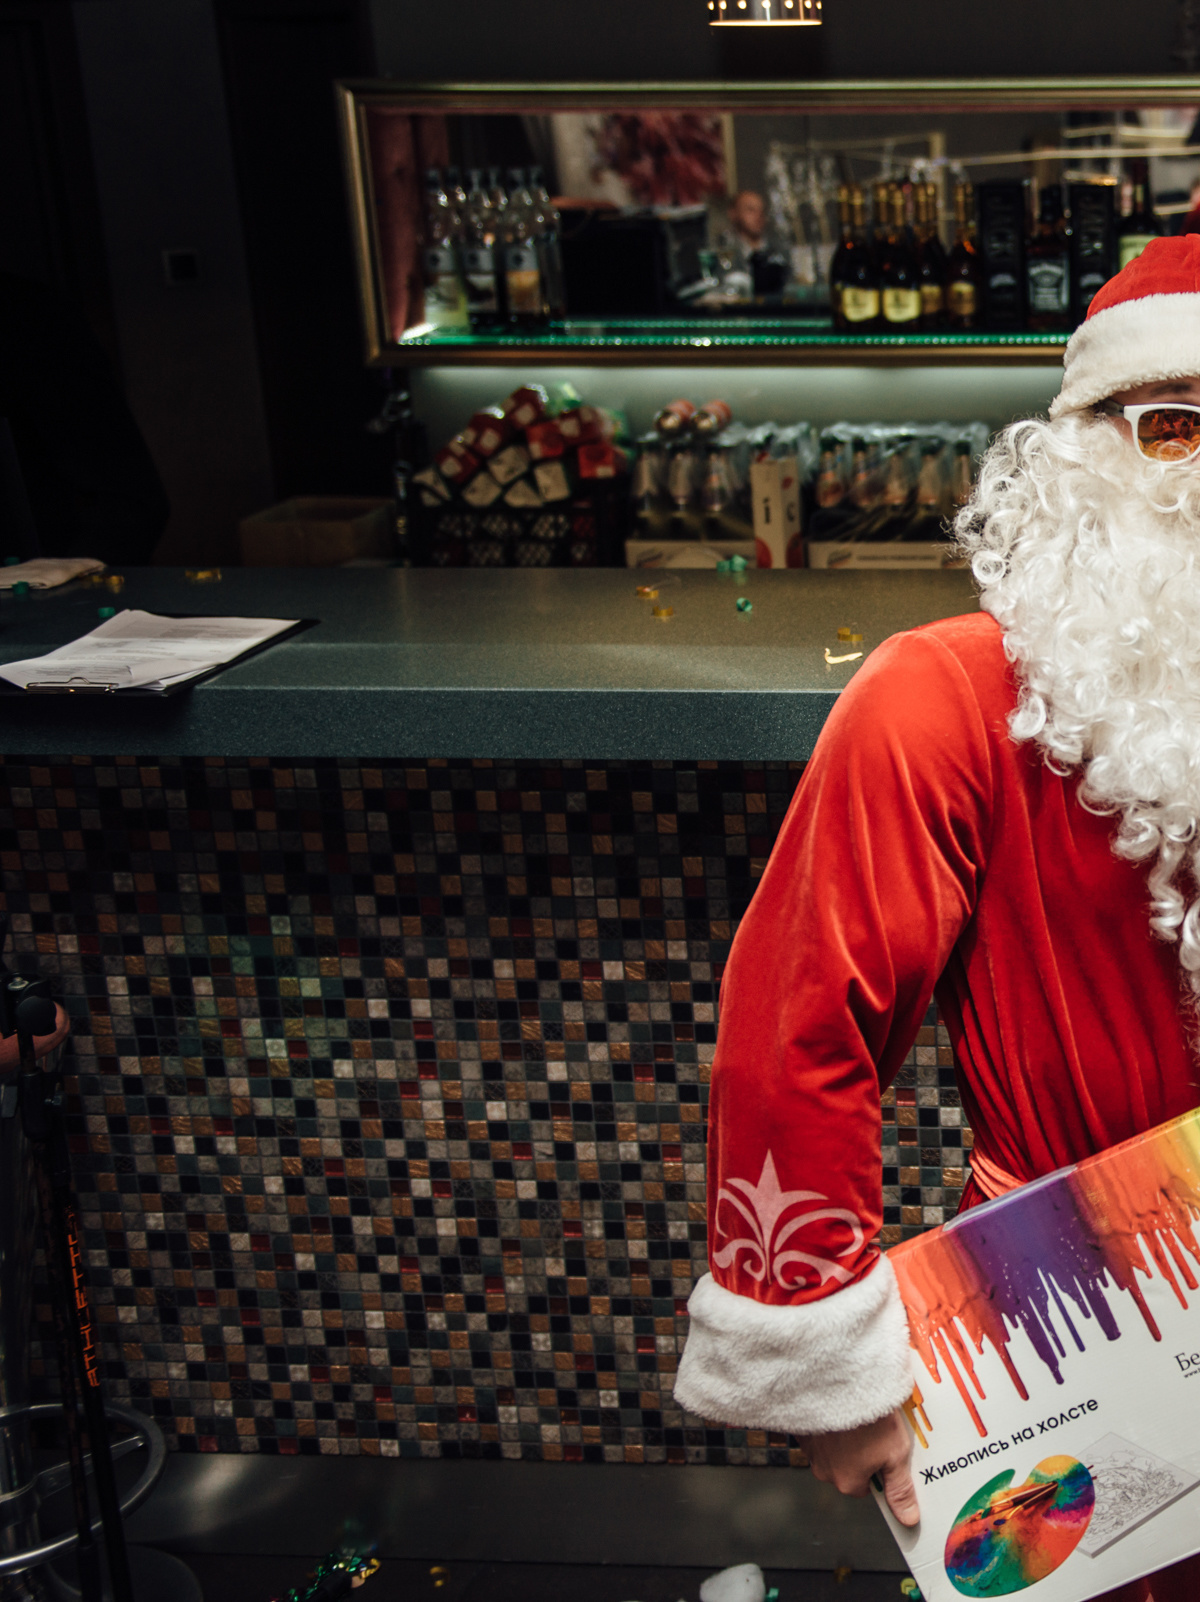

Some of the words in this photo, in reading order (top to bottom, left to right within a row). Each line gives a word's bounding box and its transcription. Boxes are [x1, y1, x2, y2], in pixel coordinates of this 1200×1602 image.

[919, 1440, 1010, 1485] Живопись
[1011, 1427, 1035, 1445] на
[1036, 1399, 1099, 1434] холсте
